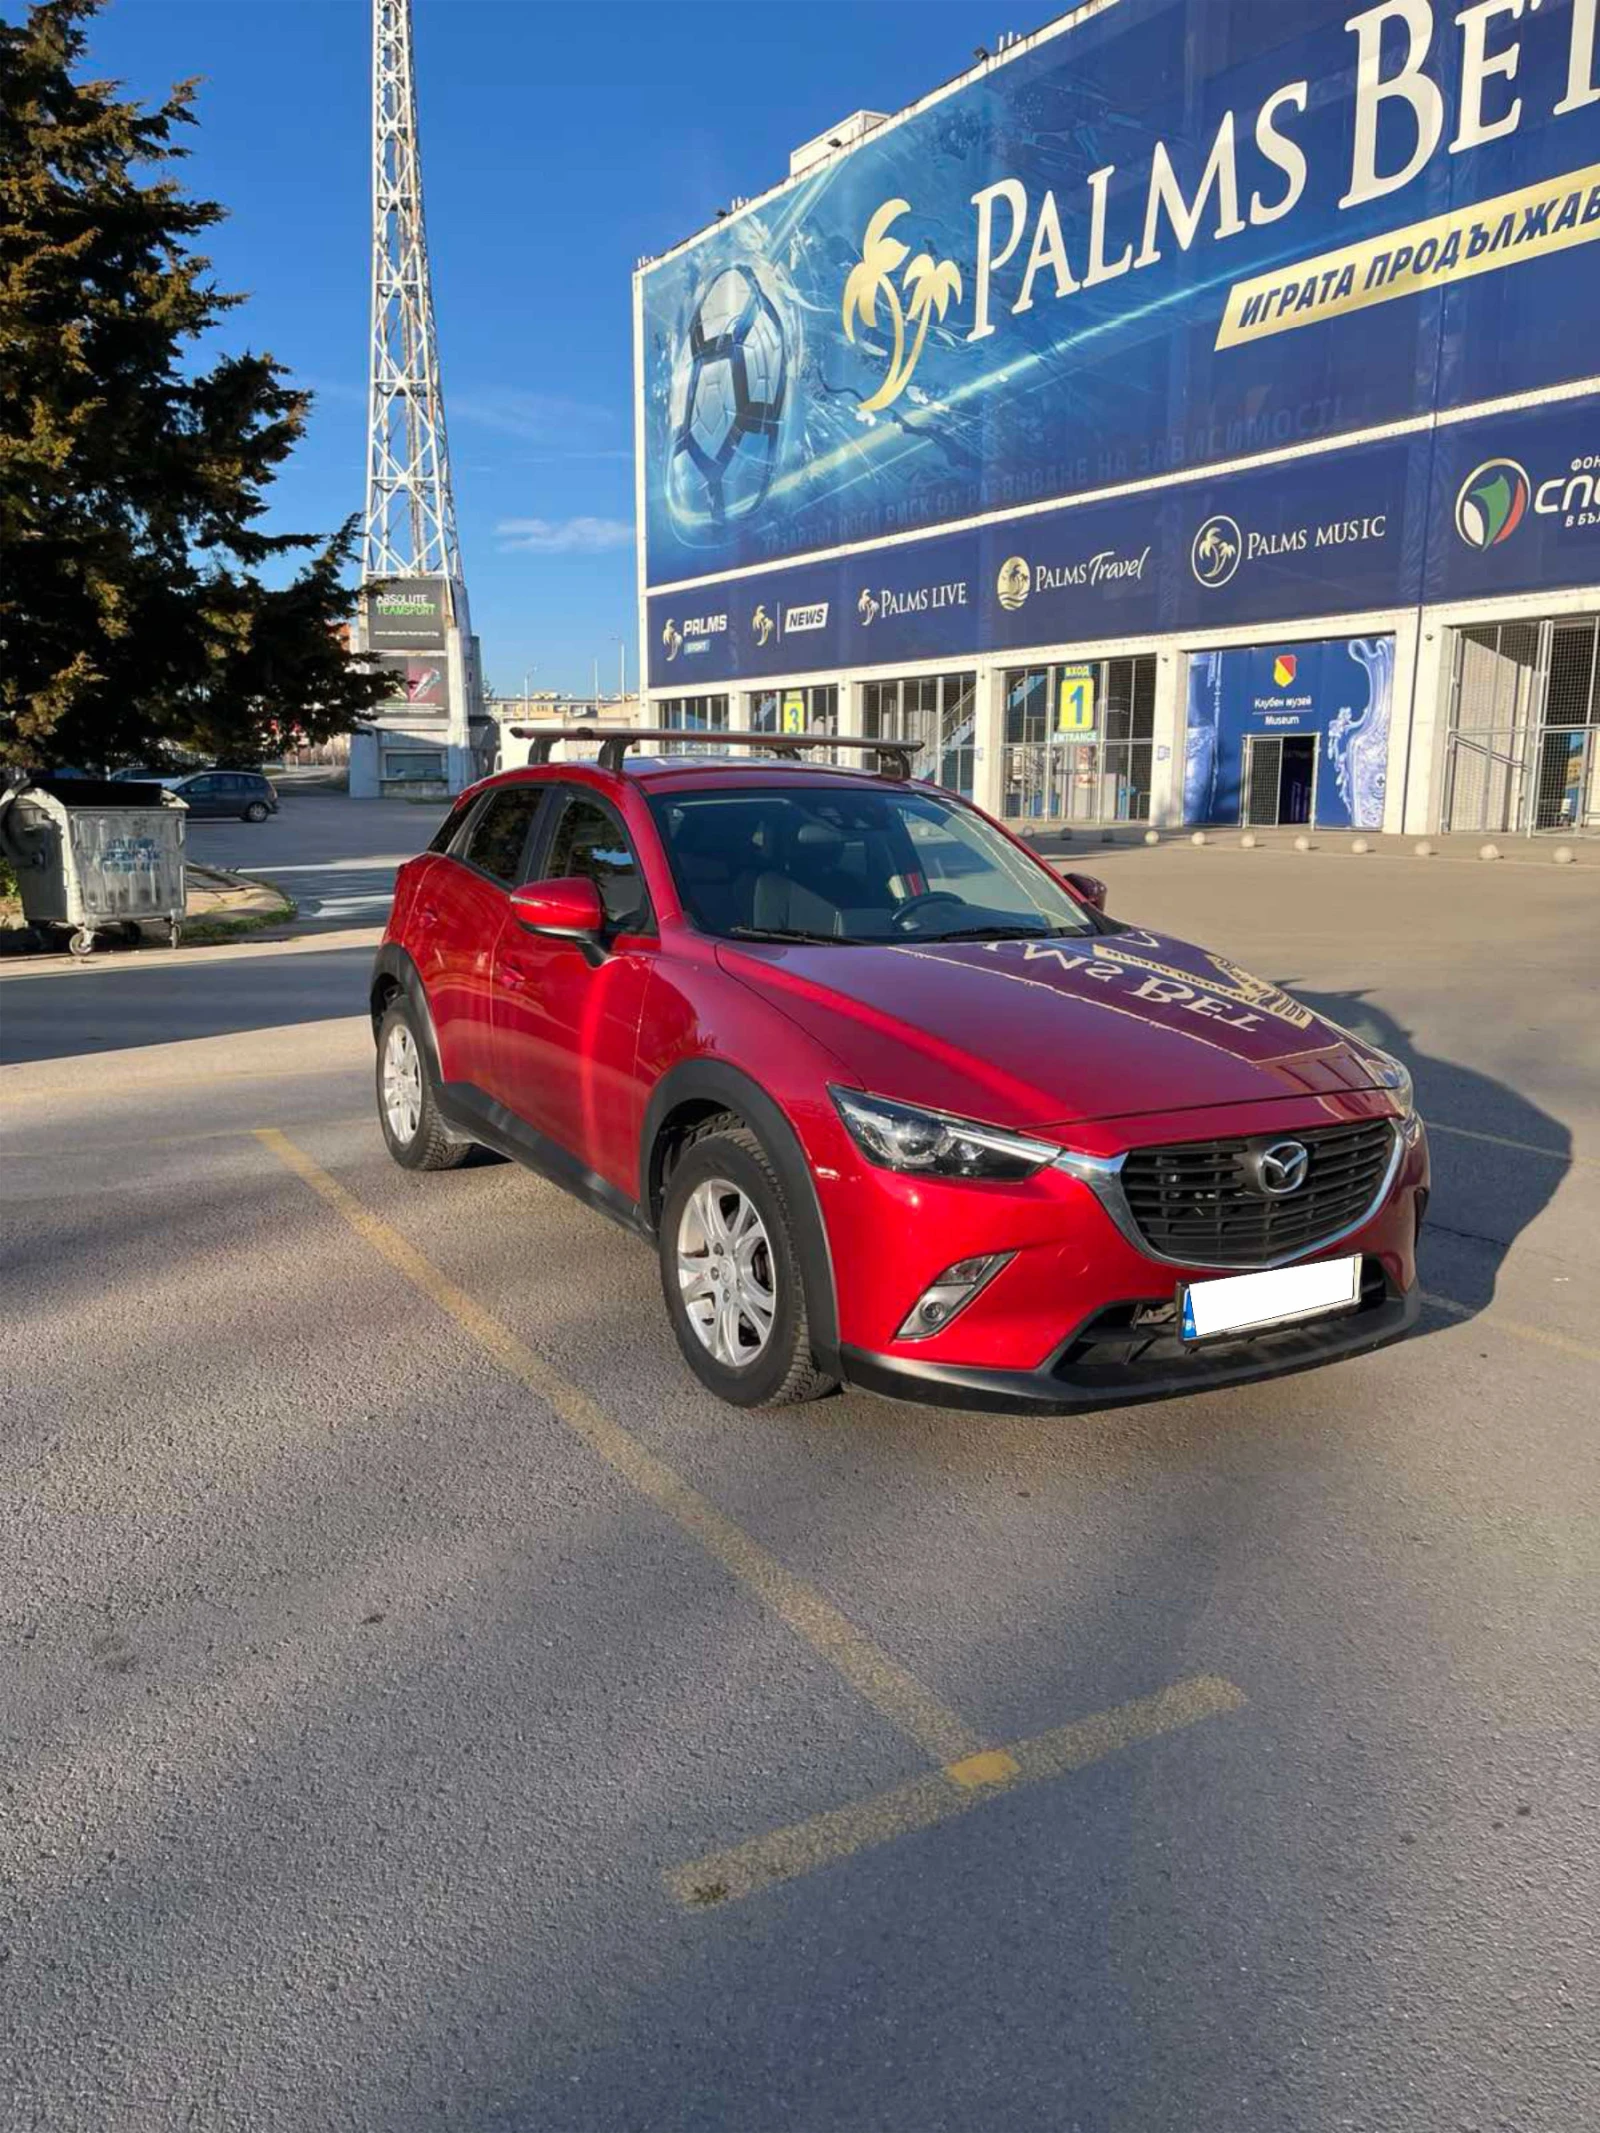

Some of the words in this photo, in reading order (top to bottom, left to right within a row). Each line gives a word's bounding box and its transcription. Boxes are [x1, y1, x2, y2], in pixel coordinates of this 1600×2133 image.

[1238, 264, 1357, 328] ИГРАТА
[1534, 475, 1600, 514] СП
[1315, 515, 1386, 547] MUSIC
[1564, 515, 1574, 528] В
[1088, 546, 1151, 587] Travel
[376, 594, 429, 606] ABSOLUTE
[932, 581, 968, 607] LIVE
[377, 604, 435, 616] TEAMSPORT
[788, 608, 825, 628] NEWS
[683, 614, 727, 636] PALMS
[1070, 685, 1084, 725] 1
[788, 706, 800, 734] 3
[1264, 715, 1300, 726] Museum
